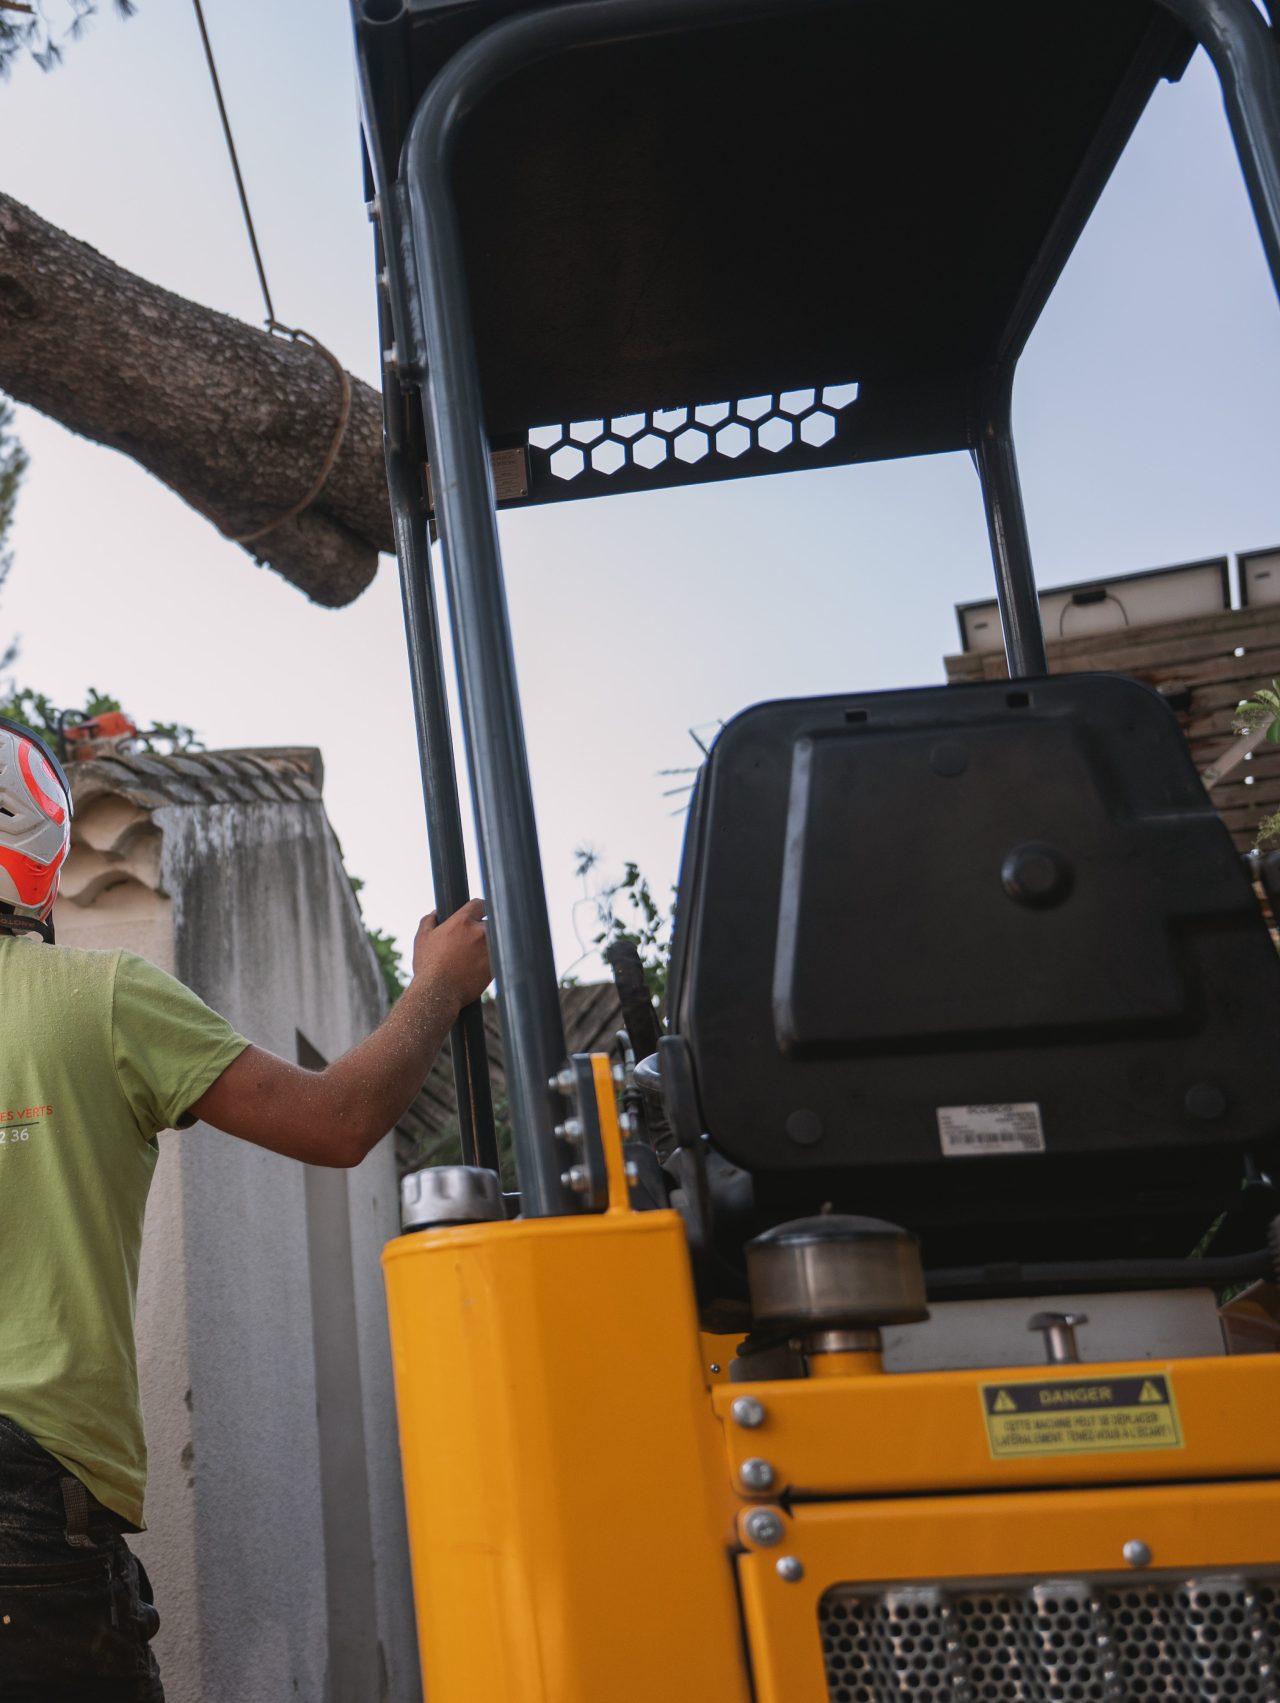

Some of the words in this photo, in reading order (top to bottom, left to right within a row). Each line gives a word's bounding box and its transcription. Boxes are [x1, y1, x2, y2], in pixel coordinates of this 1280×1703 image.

[18, 1105, 53, 1120] VERTS
[11, 1128, 29, 1143] 36
[1039, 1386, 1113, 1404] DANGER
